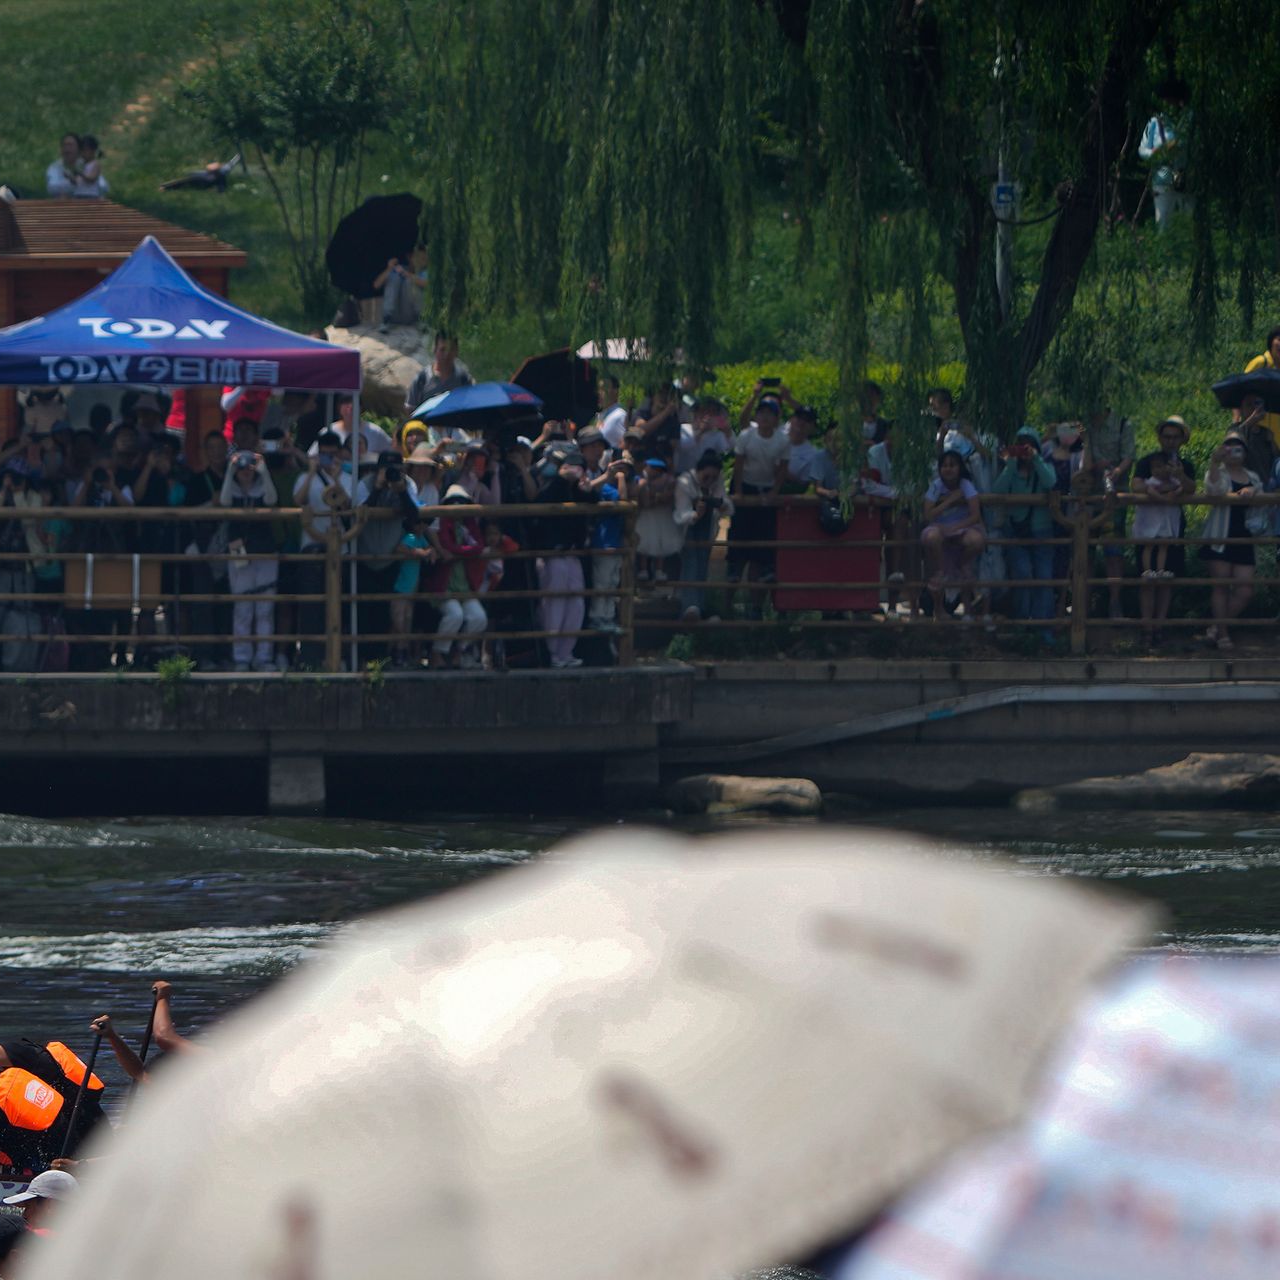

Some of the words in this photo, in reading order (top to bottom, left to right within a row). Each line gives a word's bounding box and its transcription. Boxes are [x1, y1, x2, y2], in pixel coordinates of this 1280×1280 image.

[78, 317, 230, 339] TODAY
[41, 355, 131, 383] TODAY
[138, 356, 280, 385] 今日体育
